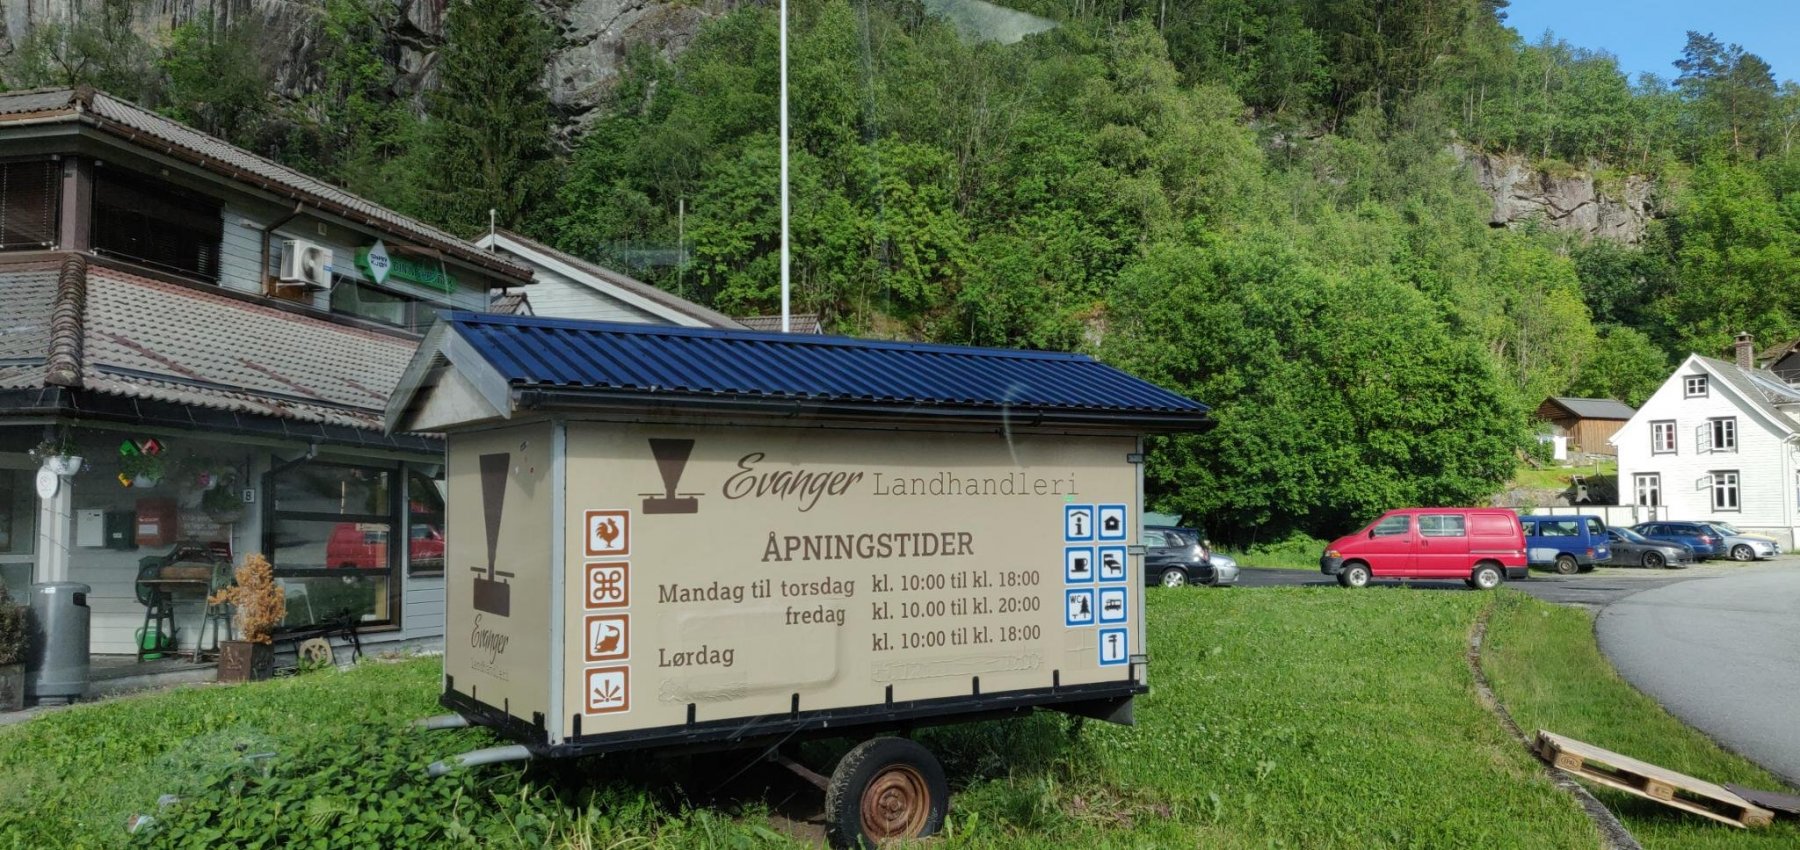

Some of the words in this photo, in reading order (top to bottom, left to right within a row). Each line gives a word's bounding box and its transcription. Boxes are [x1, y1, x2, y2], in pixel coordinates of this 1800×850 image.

[722, 452, 863, 513] Evanger
[873, 472, 1080, 496] Landhandleri
[761, 531, 974, 562] ÅPNINGSTIDER
[658, 581, 745, 603] Mandag
[751, 579, 771, 598] til
[781, 576, 855, 598] torsdag
[872, 574, 893, 592] kl.
[901, 574, 945, 591] 10:00
[951, 571, 967, 588] til
[973, 570, 992, 588] kl.
[999, 570, 1040, 587] 18:00
[1070, 595, 1082, 604] WC
[785, 605, 846, 626] fredag
[872, 602, 893, 620] kl.
[901, 601, 945, 618] 10.00
[951, 598, 967, 615] til
[973, 597, 992, 614] kl.
[999, 596, 1040, 613] 20:00
[471, 613, 509, 665] Evanger
[658, 645, 735, 668] Lørdag
[872, 633, 894, 651] kl.
[901, 631, 945, 649] 10:00
[951, 628, 967, 645] til
[973, 626, 993, 644] kl.
[1000, 625, 1041, 642] 18:00
